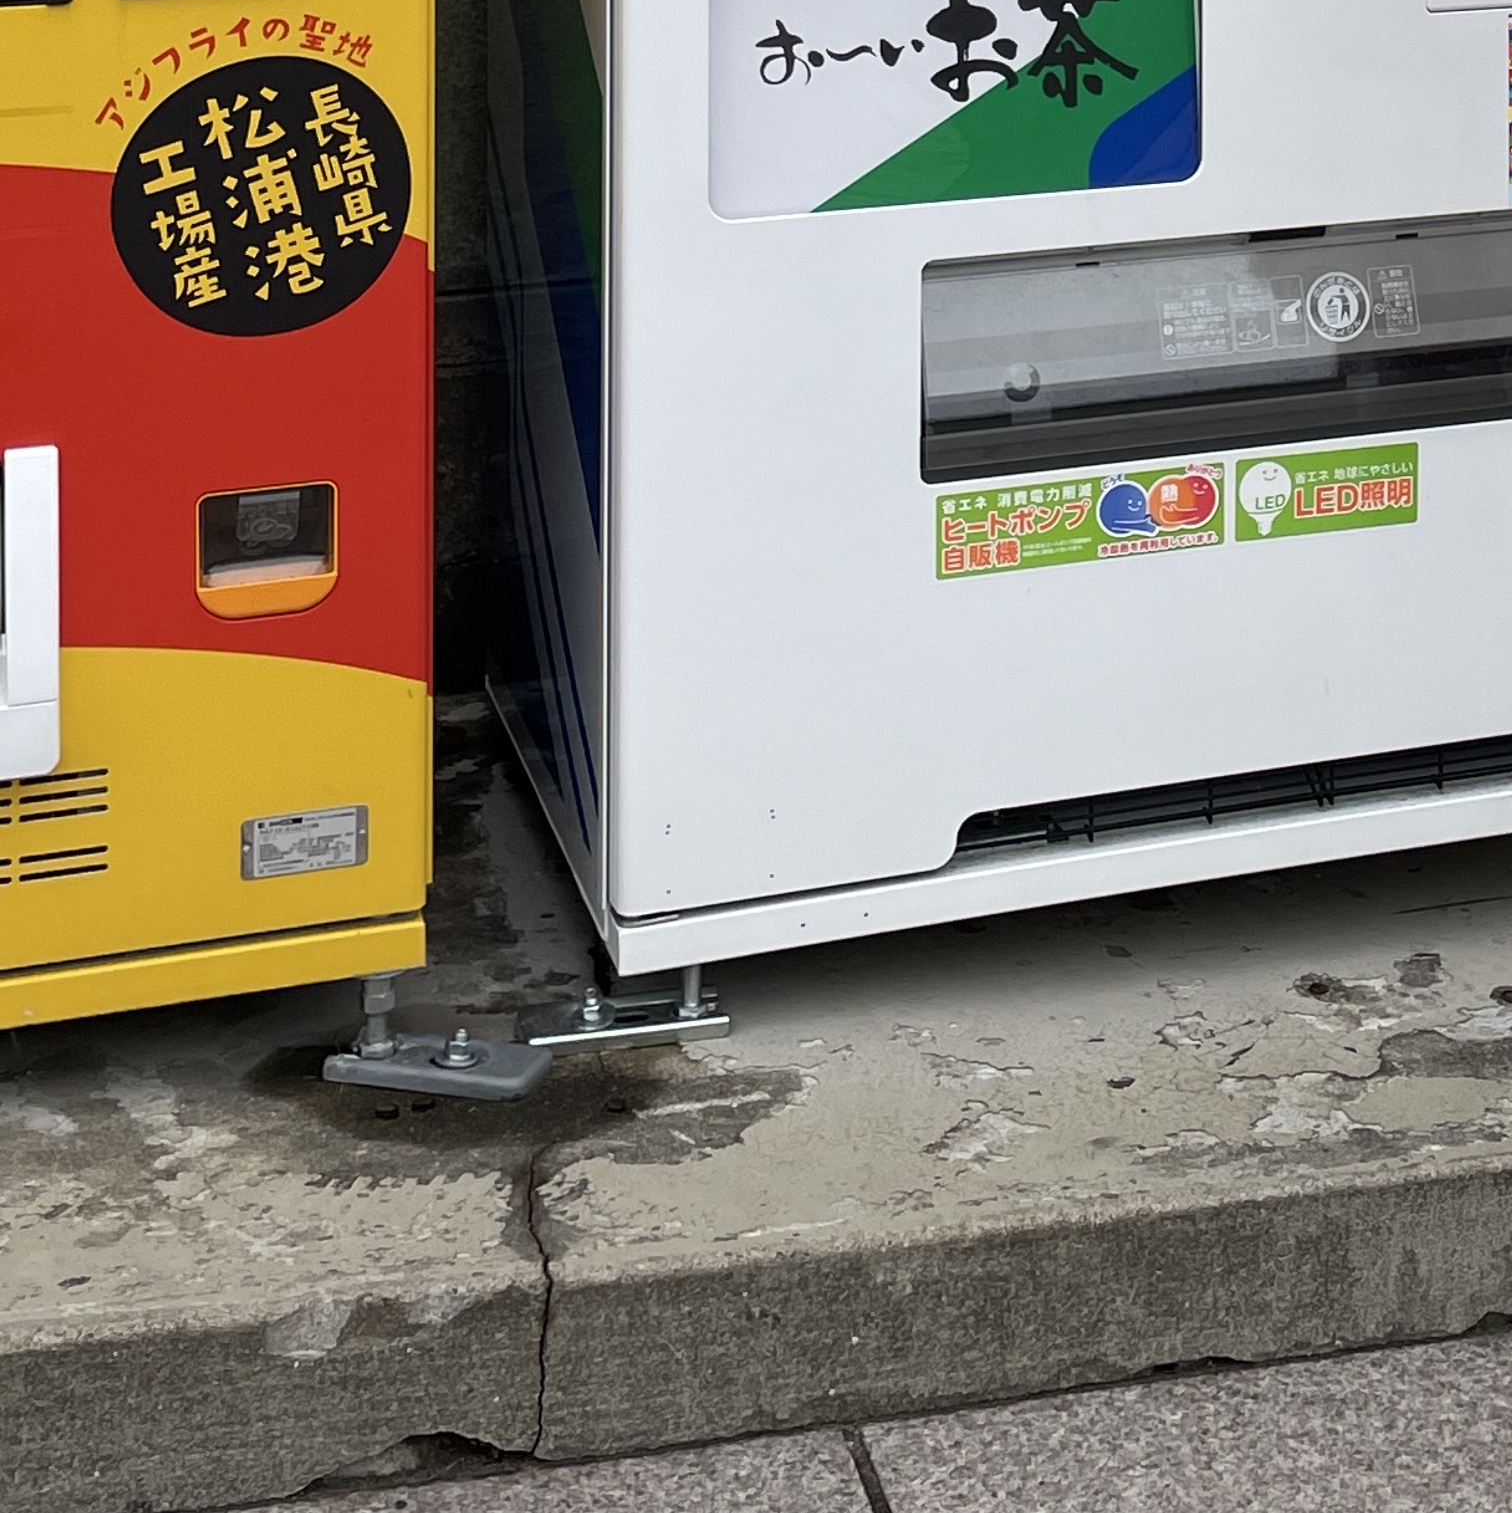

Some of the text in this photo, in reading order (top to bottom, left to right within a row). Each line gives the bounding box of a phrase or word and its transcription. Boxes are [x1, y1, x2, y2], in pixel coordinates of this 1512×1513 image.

[94, 15, 374, 131] アジフライの聖地
[305, 83, 393, 248] 長崎県
[198, 86, 325, 301] 松浦港
[139, 140, 227, 309] 工場産
[1294, 461, 1414, 486] 省エネ 地球にやさしい
[941, 482, 1093, 512] 省エネ 消費電力削減
[1254, 494, 1286, 511] LED
[1292, 477, 1414, 520] LED照明
[940, 499, 1092, 544] ヒートポンプ
[941, 541, 1020, 572] 自販機
